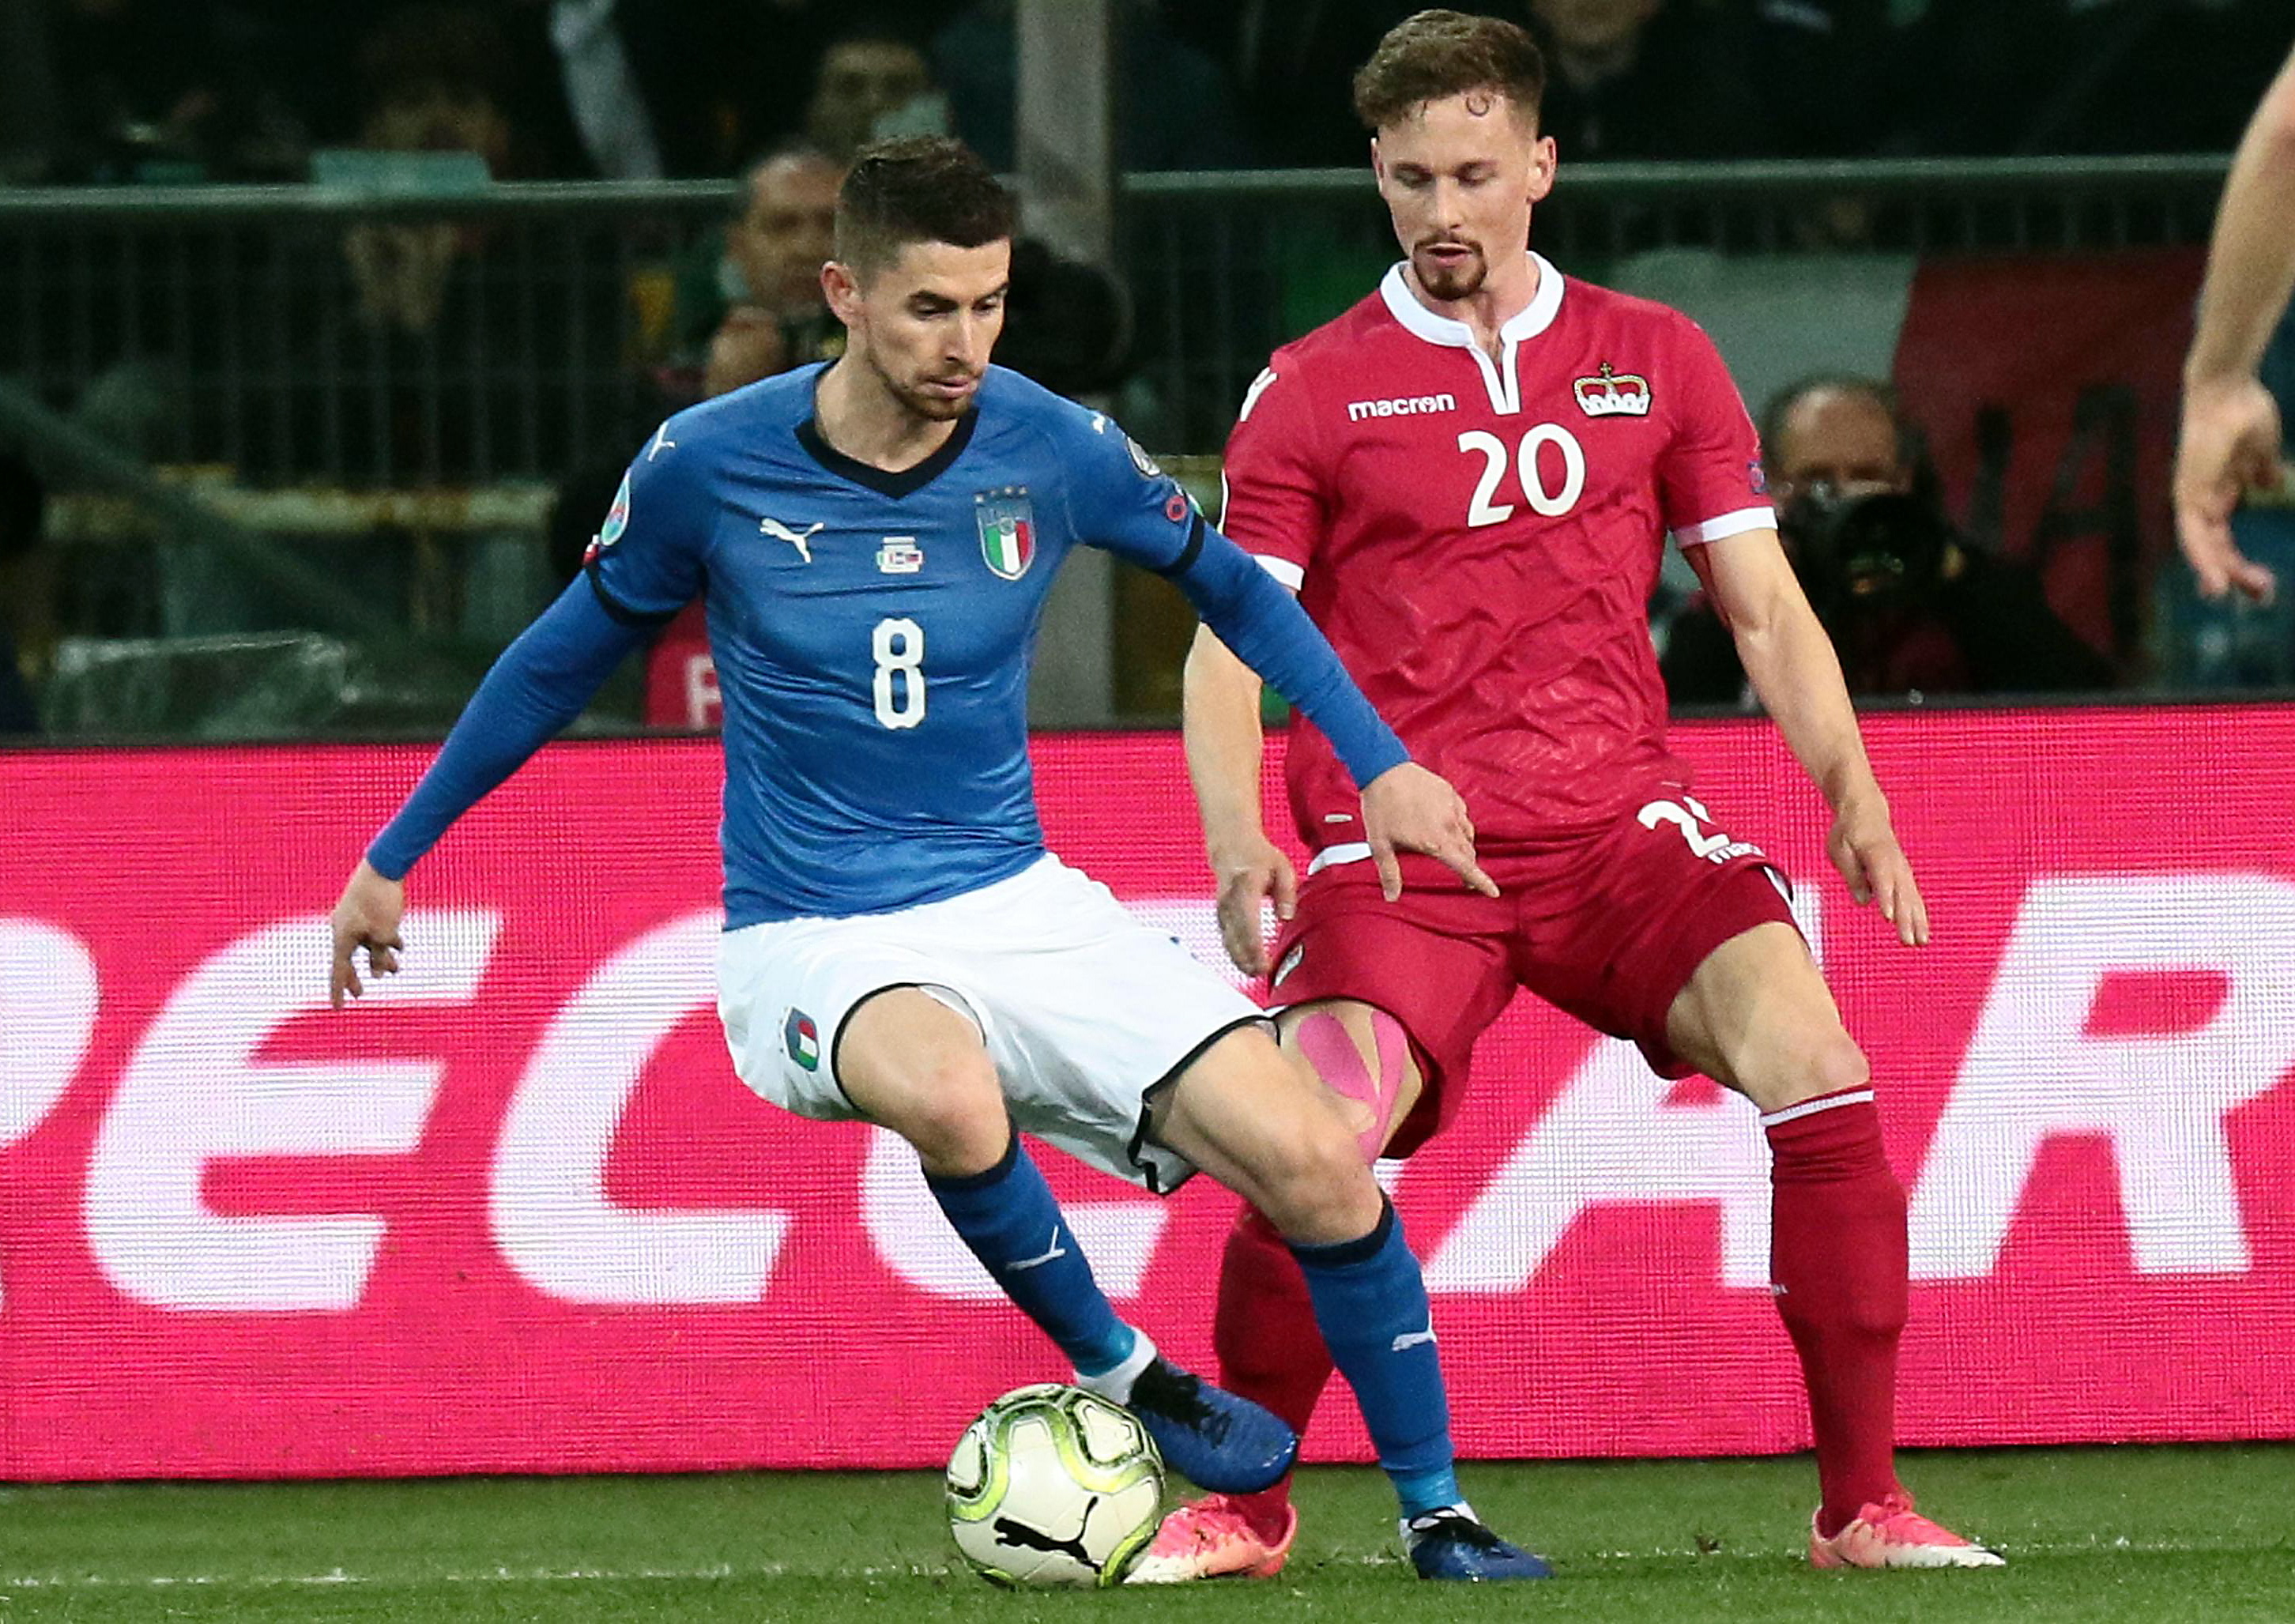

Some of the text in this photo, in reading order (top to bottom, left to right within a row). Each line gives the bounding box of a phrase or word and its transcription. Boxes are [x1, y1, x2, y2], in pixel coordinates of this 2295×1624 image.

[1347, 394, 1456, 421] macron
[1457, 423, 1586, 528] 20
[872, 617, 925, 729] 8
